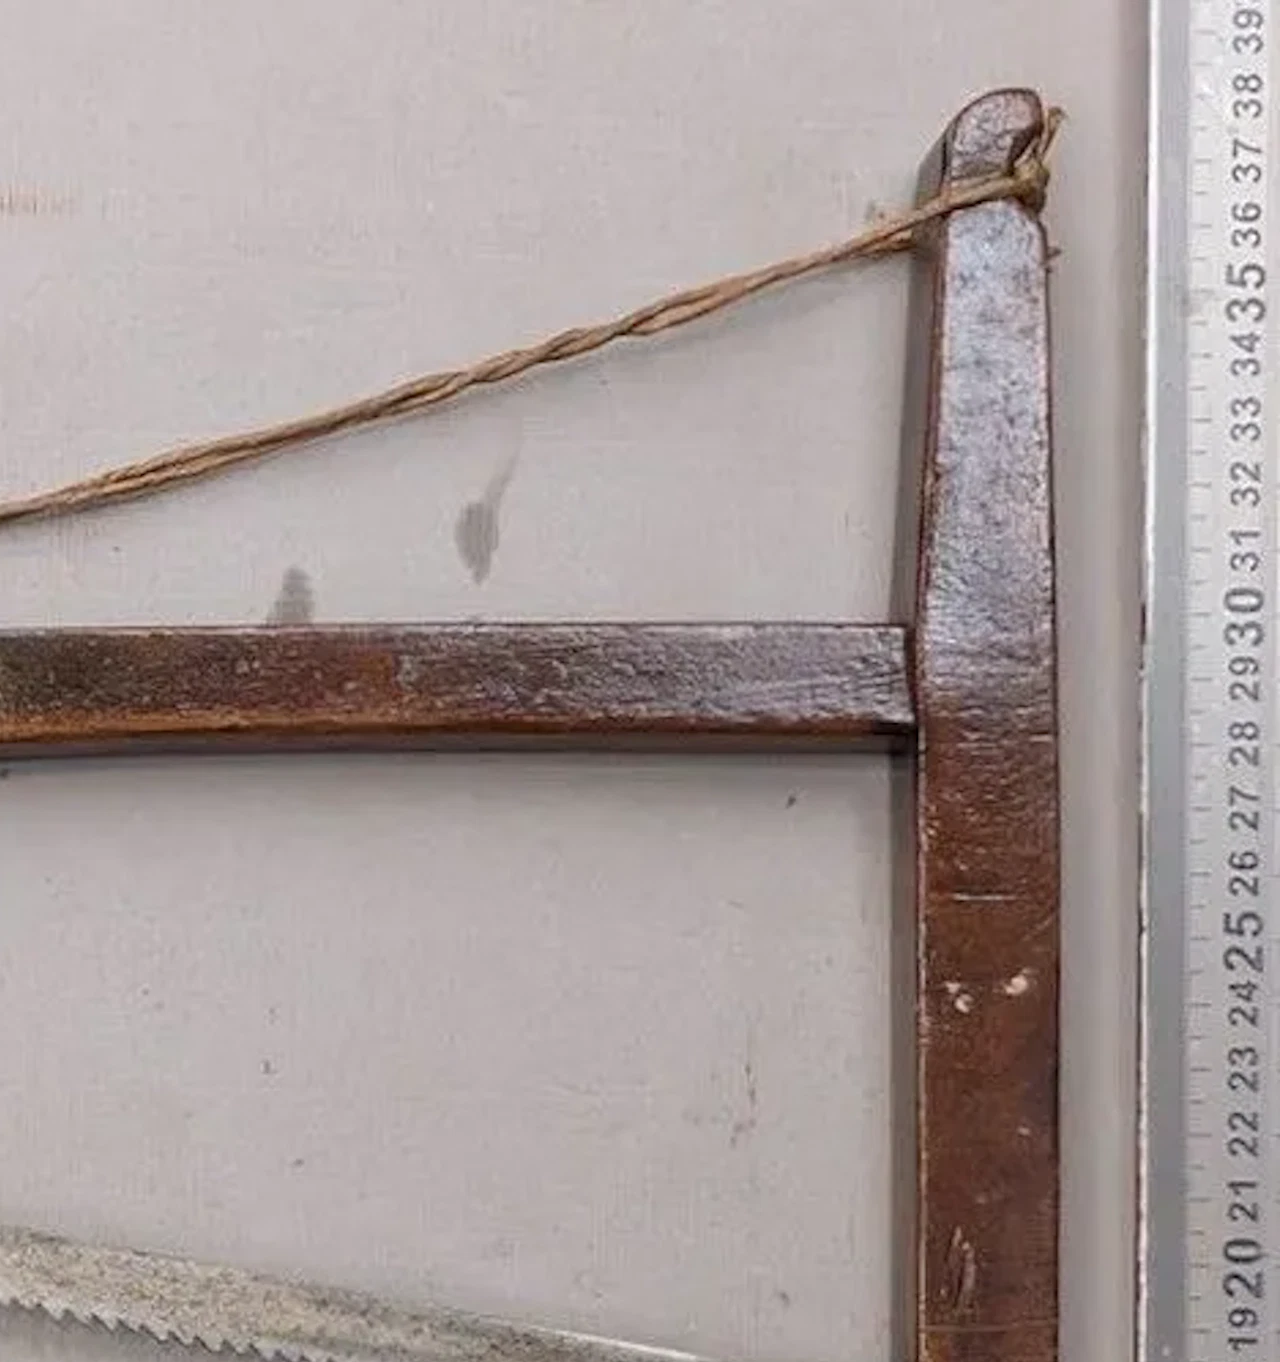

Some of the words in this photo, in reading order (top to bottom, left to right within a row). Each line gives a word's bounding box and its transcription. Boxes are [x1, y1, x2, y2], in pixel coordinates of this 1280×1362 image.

[1231, 8, 1264, 55] 39
[1231, 73, 1264, 119] 38
[1230, 137, 1263, 184] 37
[1230, 201, 1263, 249] 36
[1224, 262, 1268, 324] 35
[1228, 331, 1262, 377] 34
[1229, 396, 1262, 442] 33
[1229, 461, 1262, 508] 32
[1228, 529, 1262, 573] 31
[1223, 587, 1267, 648] 30
[1227, 656, 1261, 703] 29
[1227, 720, 1261, 768] 28
[1227, 785, 1261, 832] 27
[1227, 850, 1261, 898] 26
[1222, 910, 1265, 974] 25
[1227, 979, 1260, 1028] 24
[1226, 1046, 1260, 1094] 23
[1226, 1111, 1260, 1158] 22
[1226, 1180, 1260, 1223] 21
[1222, 1237, 1266, 1300] 20
[1226, 1306, 1260, 1353] 19
